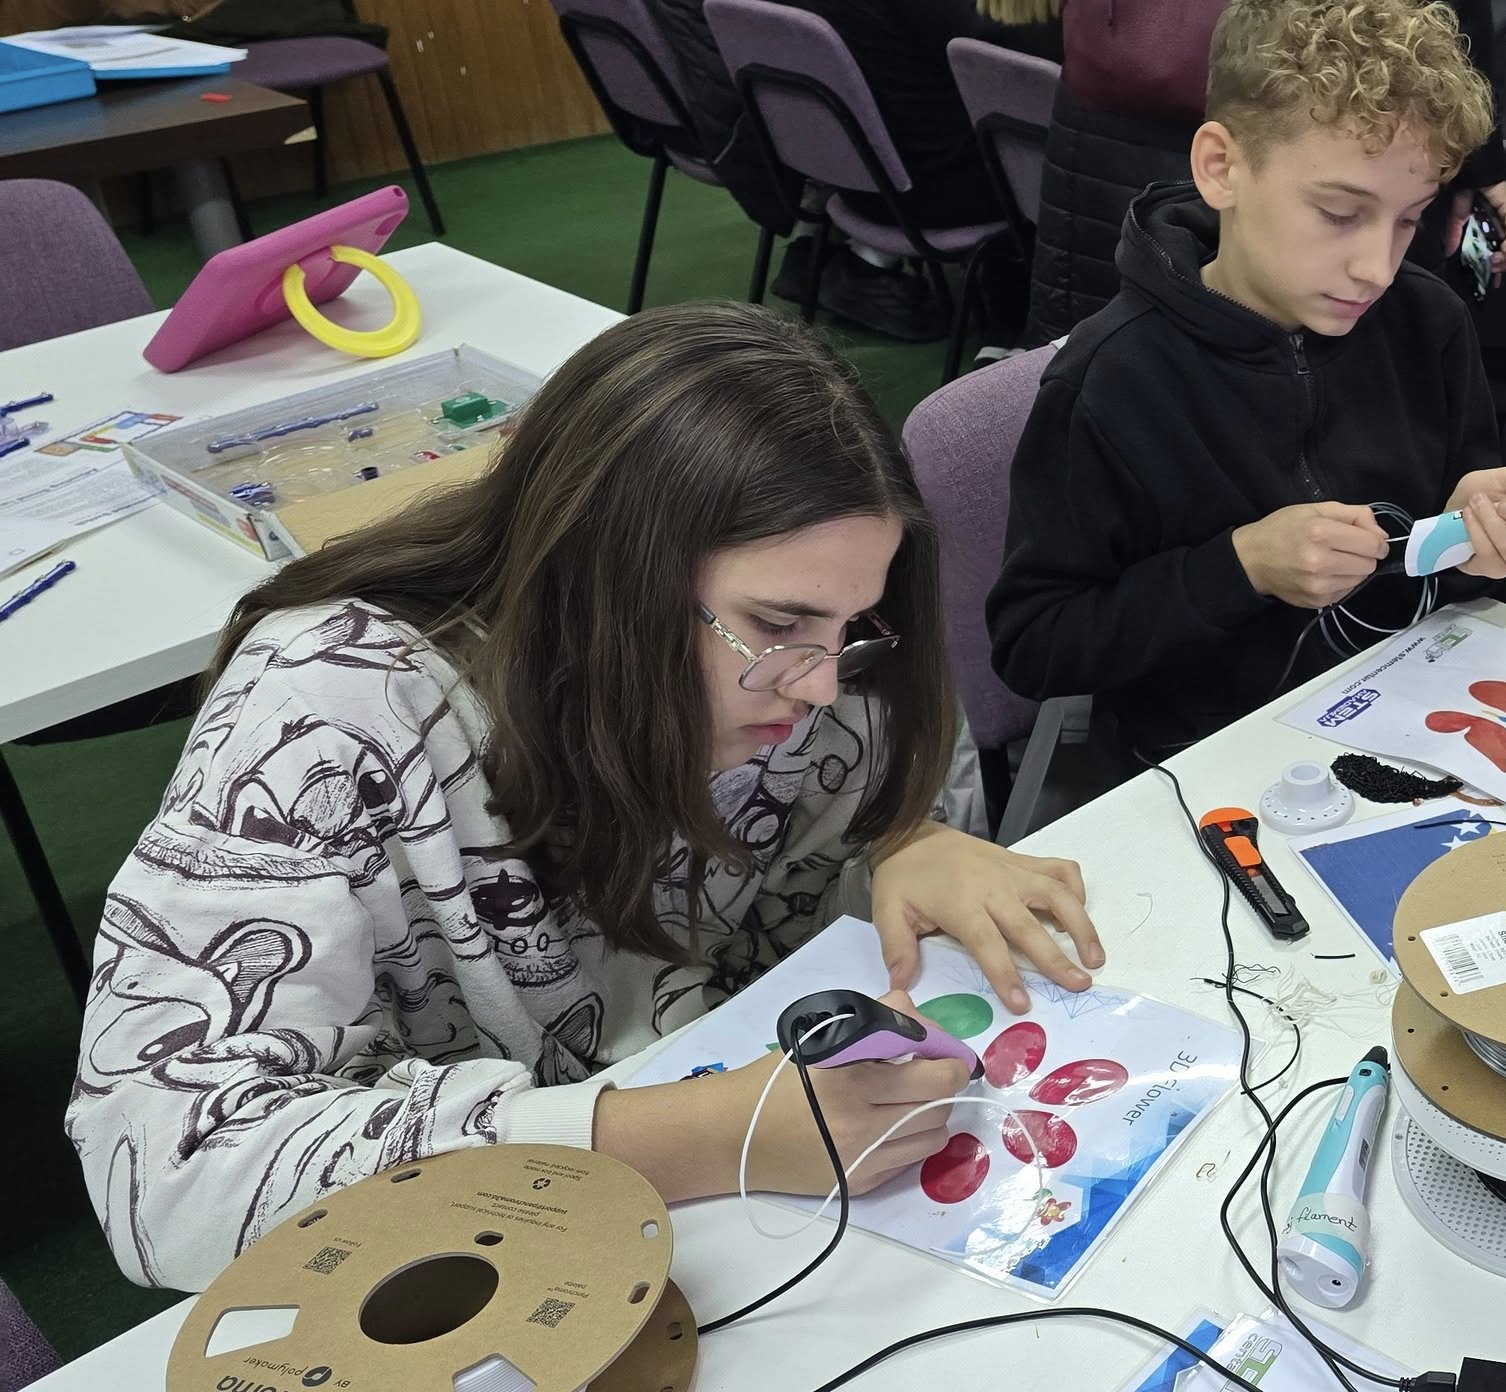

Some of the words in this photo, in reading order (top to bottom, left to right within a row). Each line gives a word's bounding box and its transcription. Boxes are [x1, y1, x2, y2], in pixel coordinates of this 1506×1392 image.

[1324, 691, 1377, 727] STEM
[1123, 1079, 1177, 1126] Flower
[555, 1225, 568, 1233] For
[1226, 1333, 1258, 1371] centa
[242, 1356, 309, 1377] polymaker
[333, 1379, 351, 1388] BY
